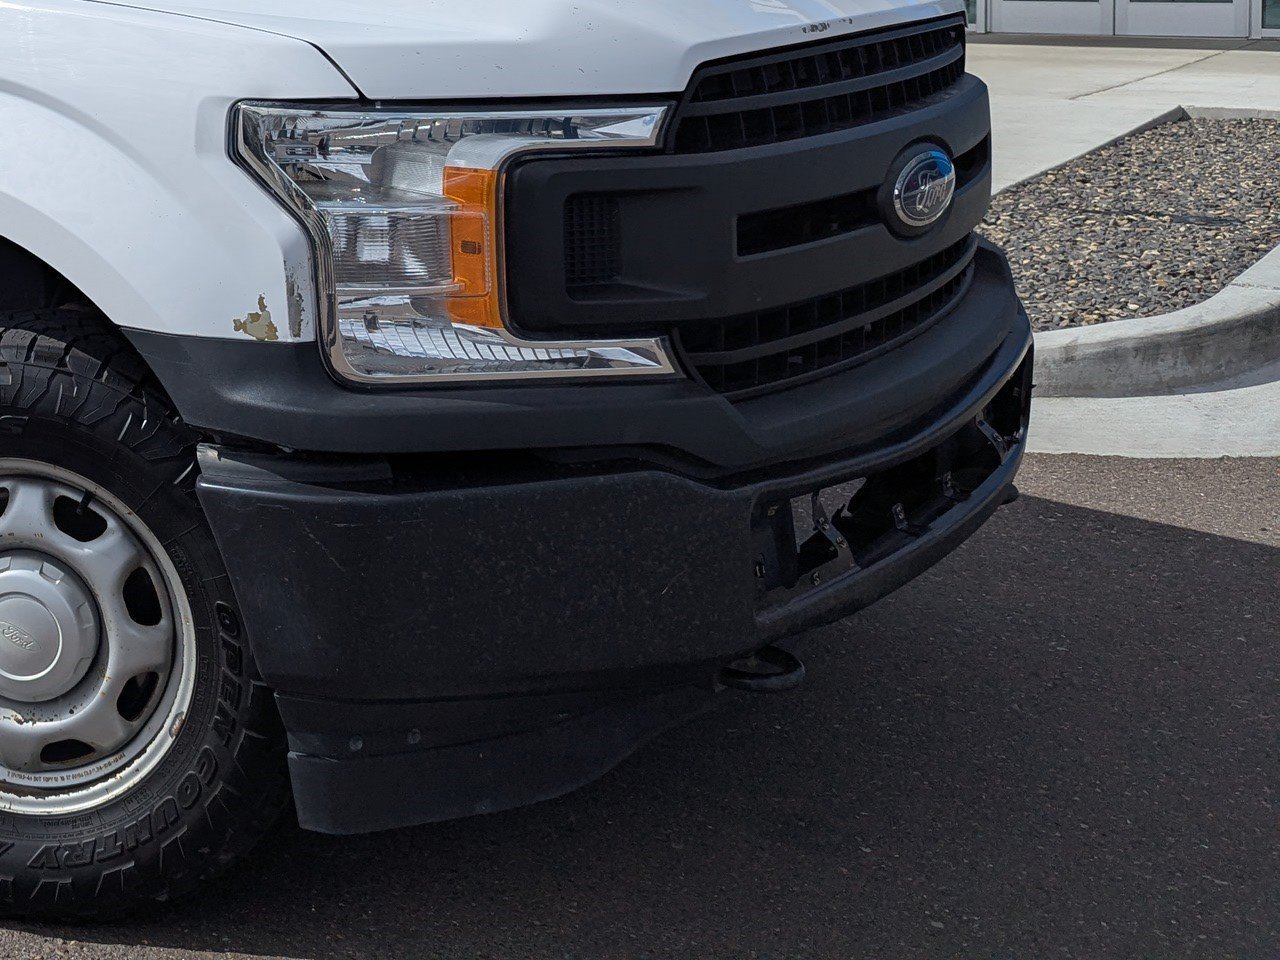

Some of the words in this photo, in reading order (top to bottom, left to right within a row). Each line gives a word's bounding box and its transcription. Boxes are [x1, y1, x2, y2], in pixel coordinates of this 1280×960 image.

[2, 625, 34, 650] Ford
[213, 600, 244, 747] OPEN
[26, 745, 218, 869] COUNTRY
